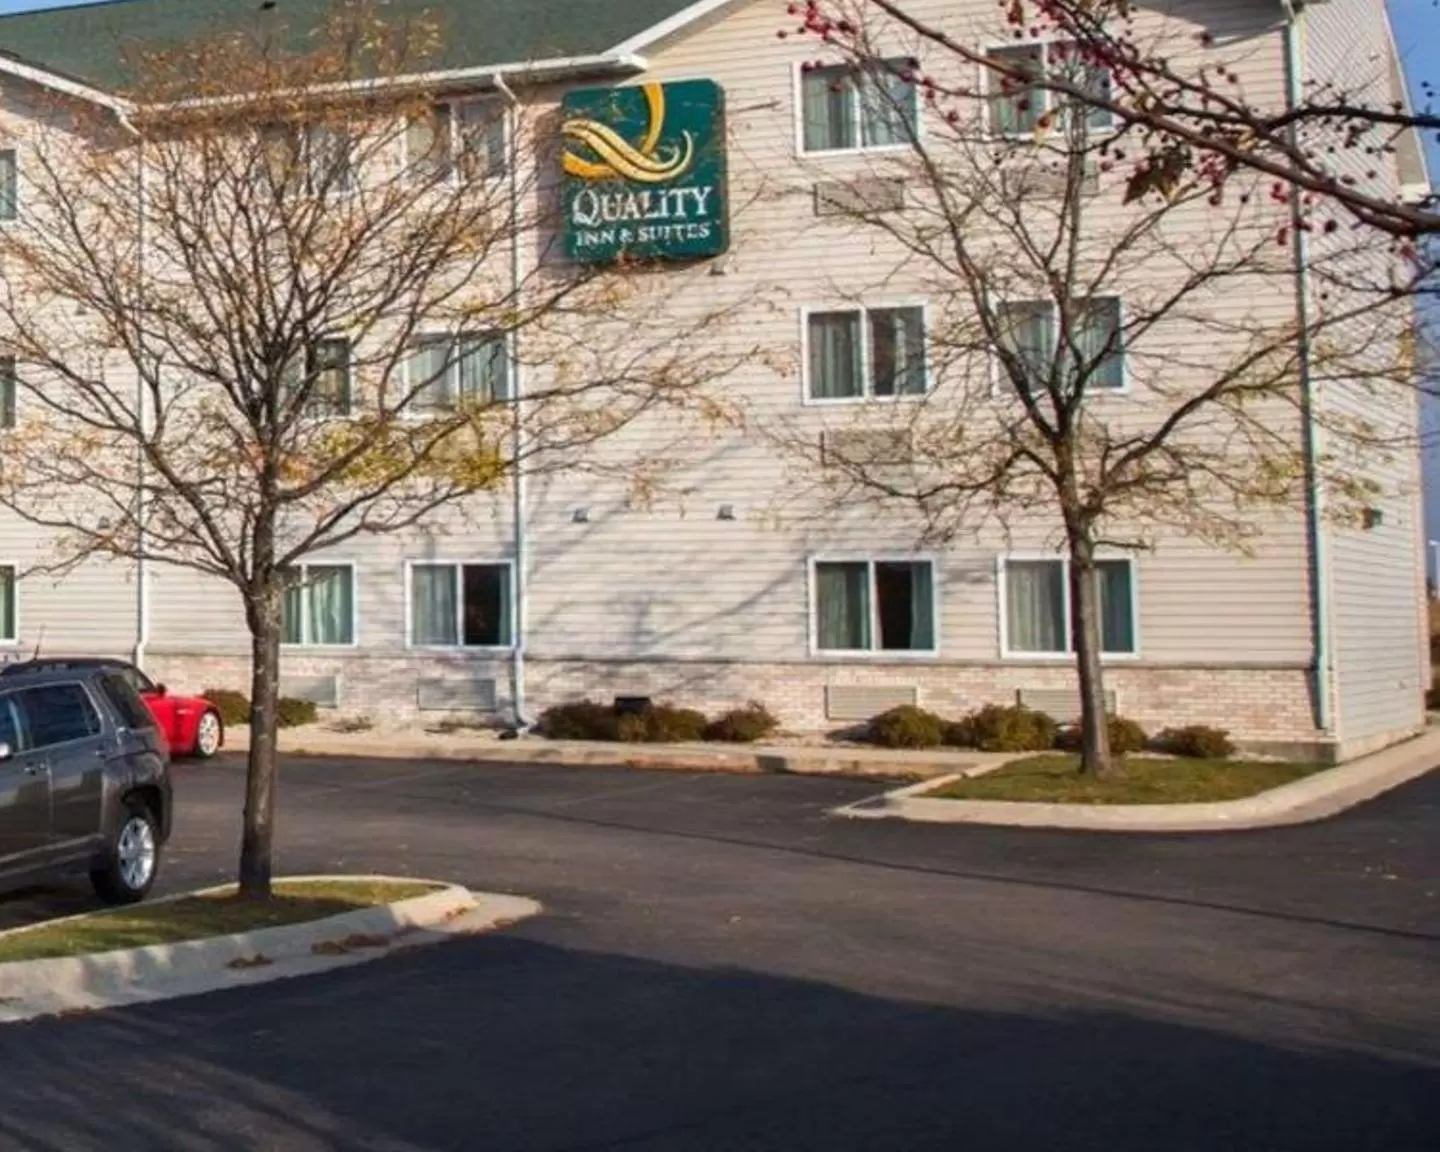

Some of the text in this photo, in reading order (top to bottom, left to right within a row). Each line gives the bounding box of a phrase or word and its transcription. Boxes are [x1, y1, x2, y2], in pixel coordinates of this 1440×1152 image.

[572, 186, 712, 227] QUALITY
[576, 222, 711, 246] INN & SUITES
